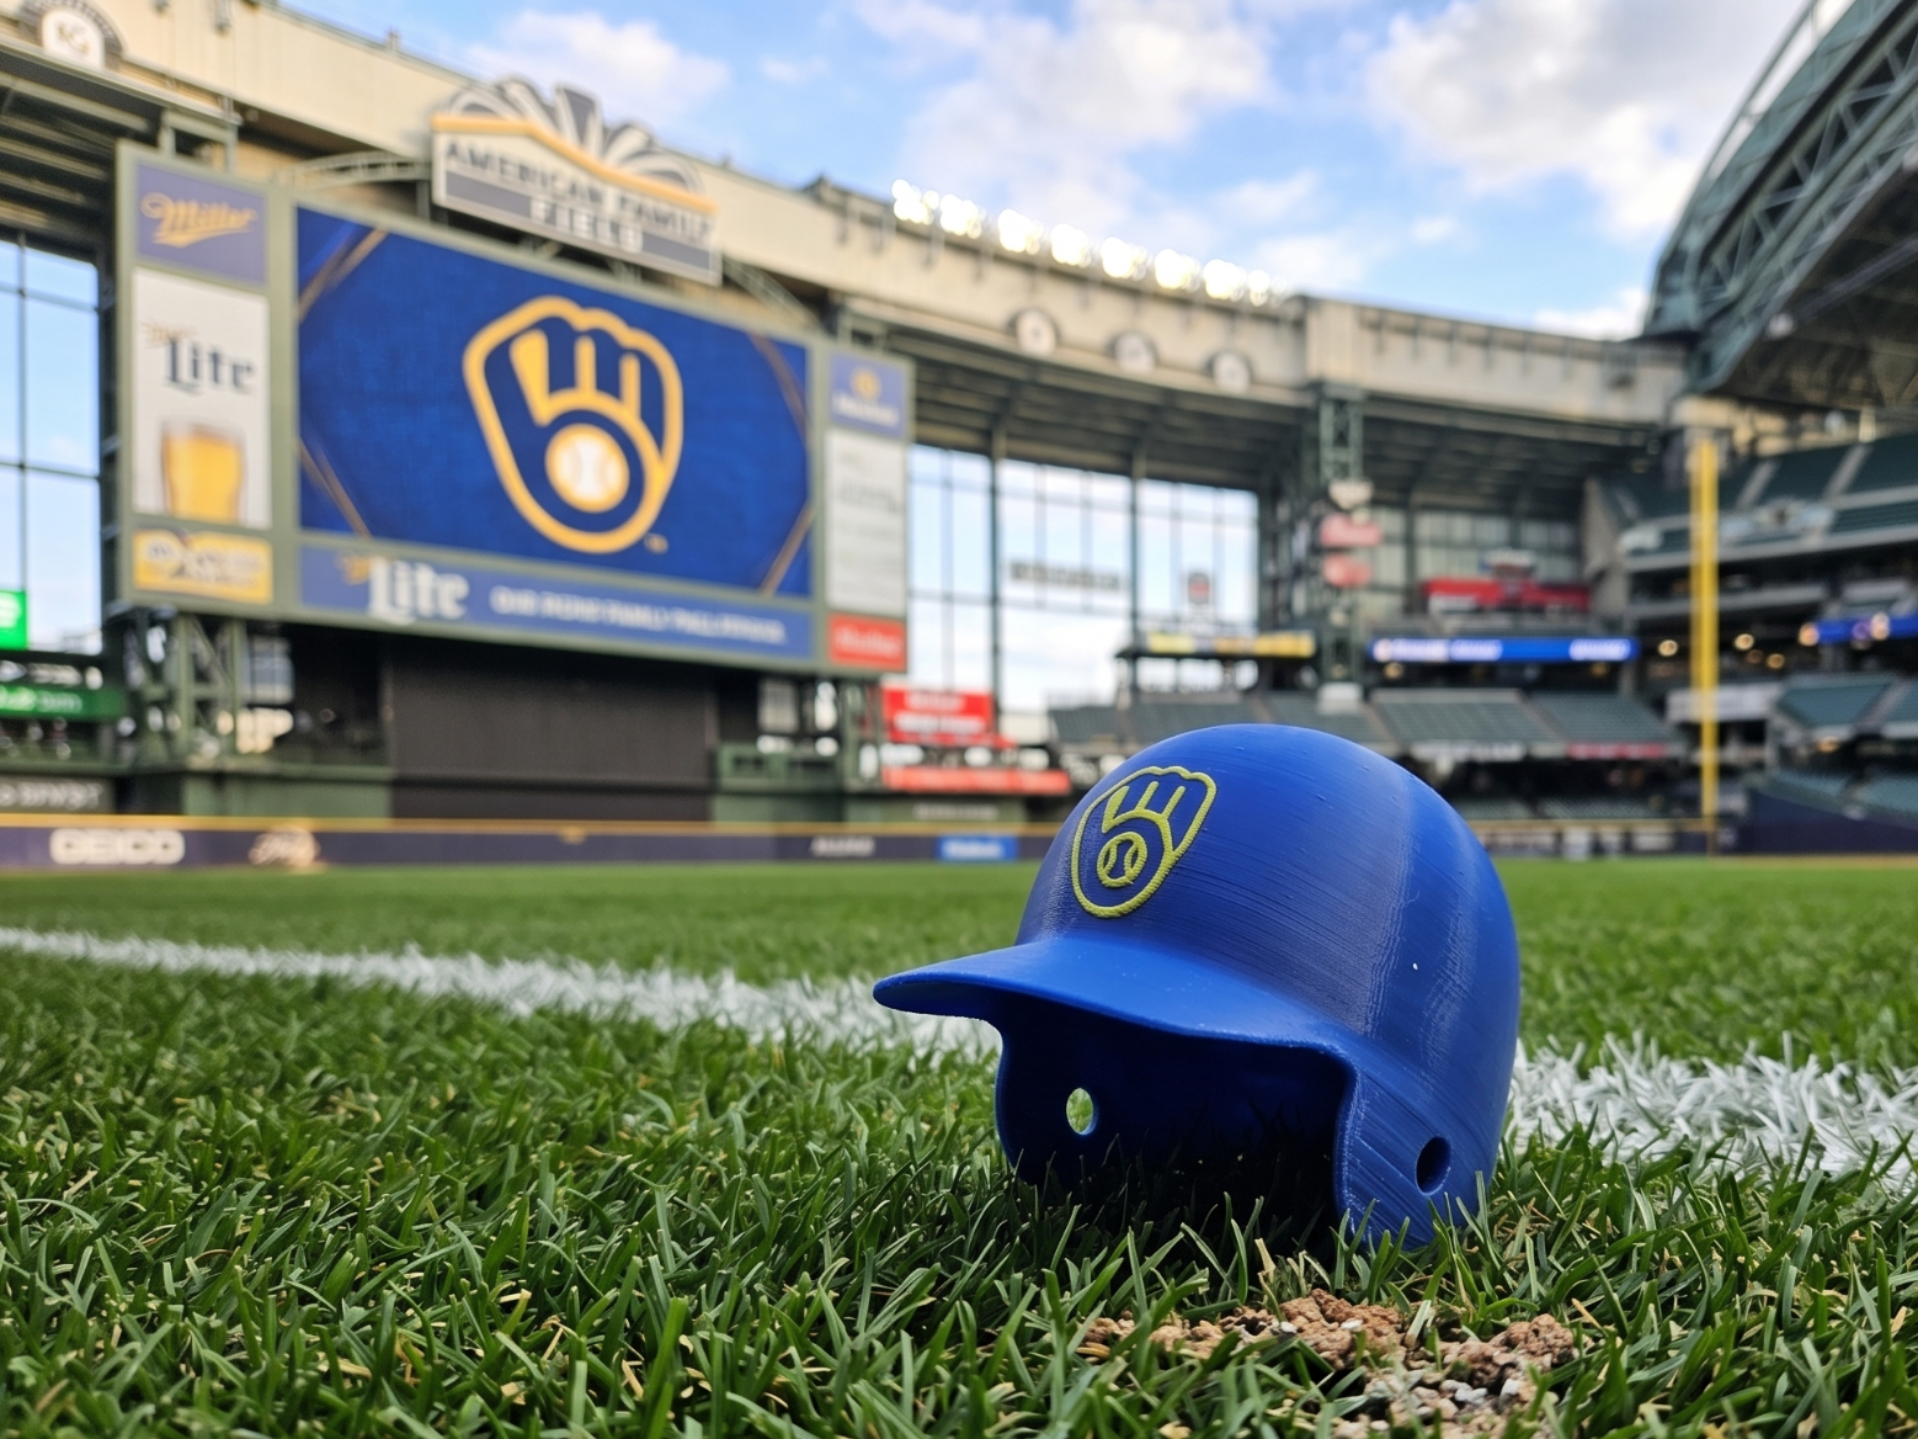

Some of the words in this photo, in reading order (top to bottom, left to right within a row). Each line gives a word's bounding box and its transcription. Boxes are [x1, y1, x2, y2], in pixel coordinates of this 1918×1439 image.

[444, 141, 603, 205] AMERICAN
[618, 194, 711, 240] FAMILY
[140, 192, 257, 248] Miller
[529, 196, 644, 254] FIELD
[164, 337, 254, 395] Lite
[369, 557, 470, 626] Lite
[50, 828, 185, 865] GEICO
